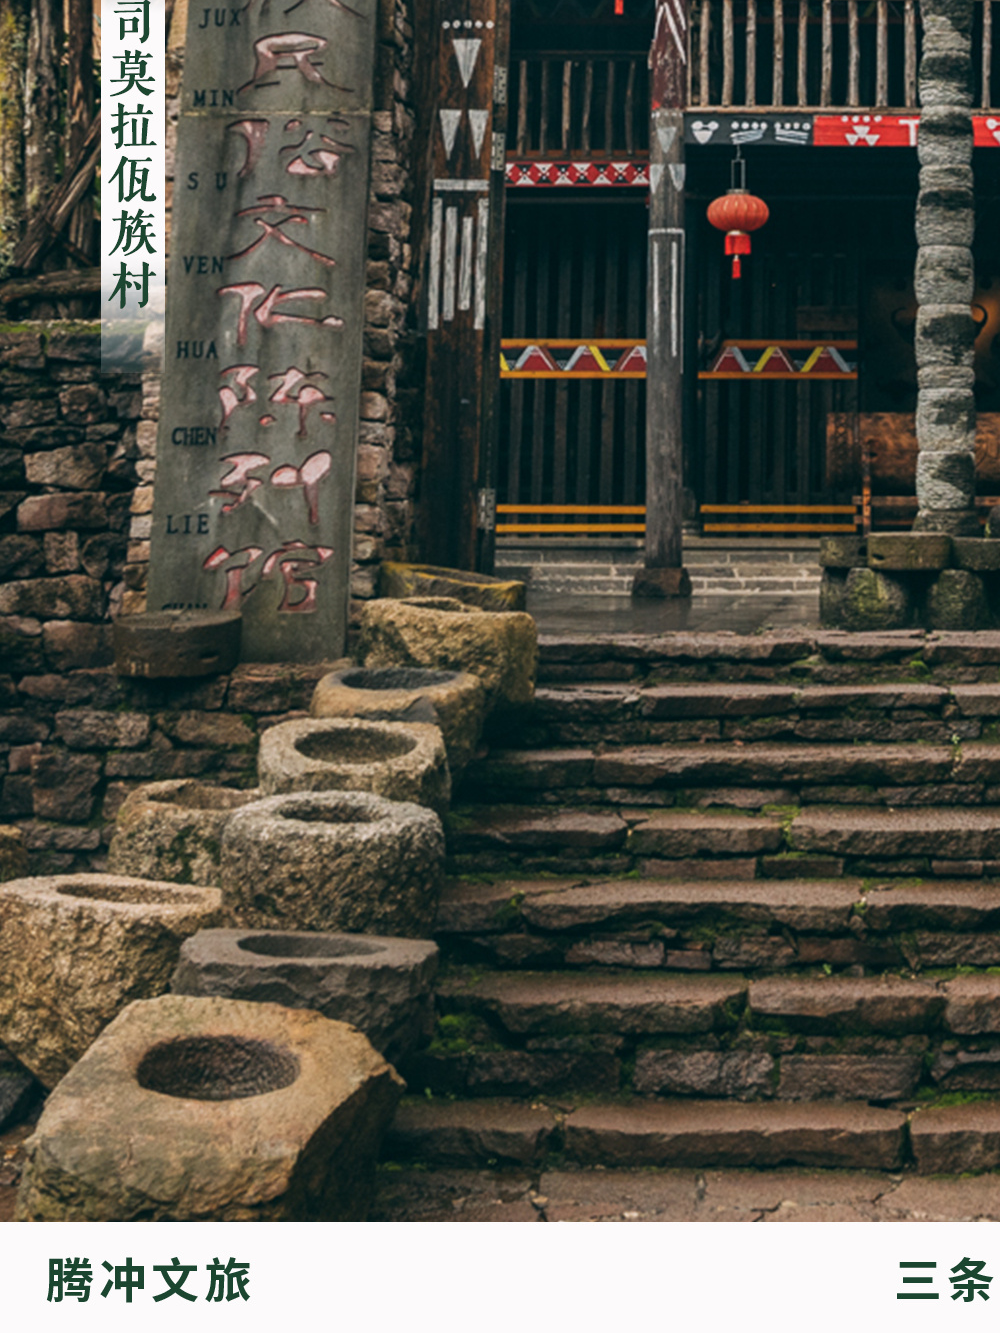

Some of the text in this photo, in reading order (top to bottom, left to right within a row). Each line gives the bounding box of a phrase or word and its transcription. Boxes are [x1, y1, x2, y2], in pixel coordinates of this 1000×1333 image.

[198, 8, 241, 29] JUX
[192, 89, 235, 107] MIN
[187, 171, 228, 190] SU
[182, 255, 225, 275] VEN
[176, 339, 219, 360] HUA
[170, 426, 218, 446] CHEN
[165, 514, 210, 535] LIE
